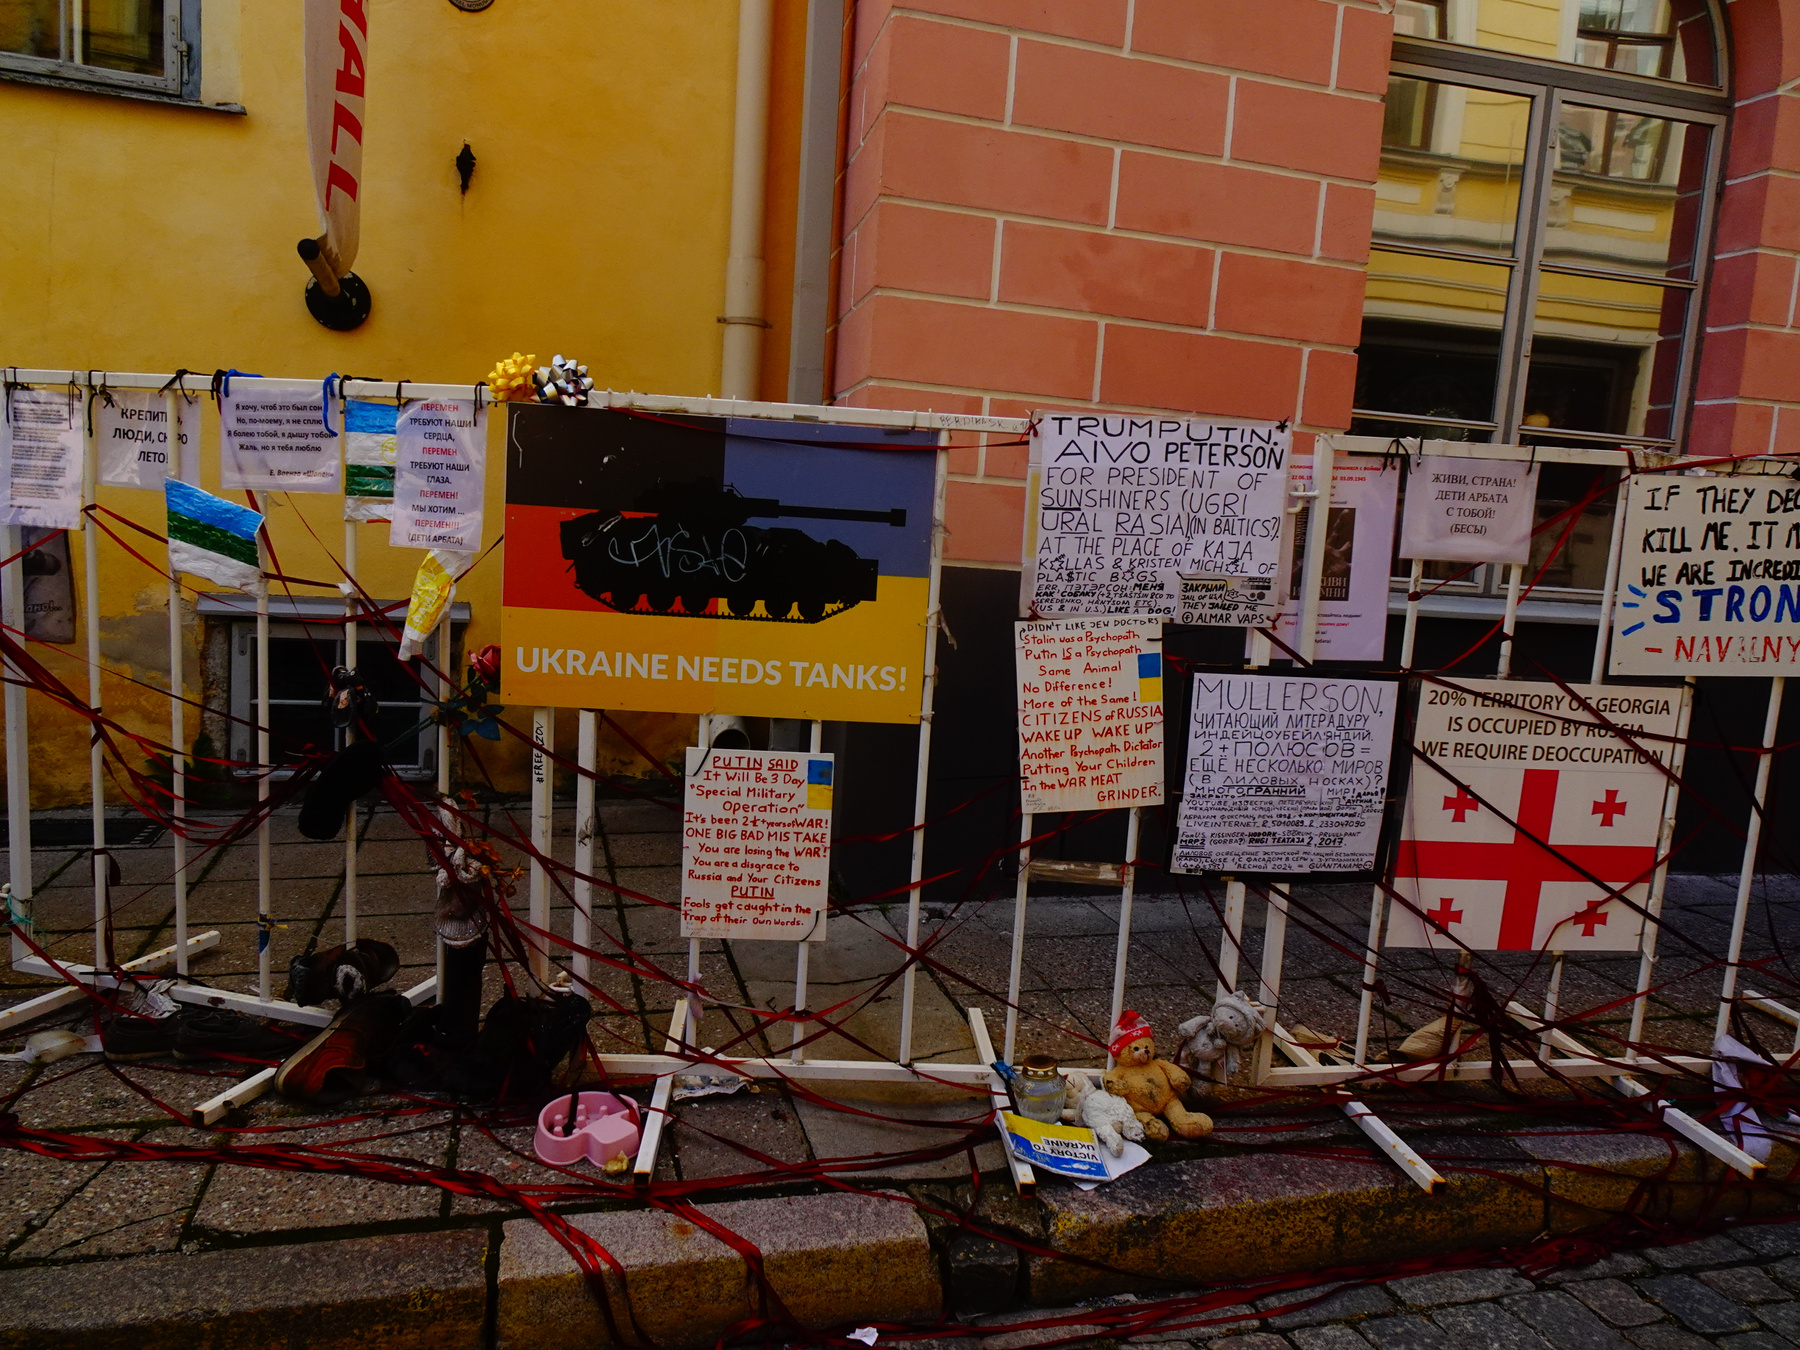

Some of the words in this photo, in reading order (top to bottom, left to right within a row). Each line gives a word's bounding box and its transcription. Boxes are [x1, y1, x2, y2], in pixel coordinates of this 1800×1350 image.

[241, 404, 259, 412] хочу,
[420, 403, 459, 412] ПЕРЕМЕН
[410, 418, 443, 426] ТРЕБУЮТ
[445, 419, 472, 428] НАШИ
[113, 428, 155, 443] ЛЮДИ,
[257, 430, 280, 438] тобой,
[424, 432, 455, 442] СЕРДЦА,
[1052, 416, 1279, 446] TRUMPUTIN.
[295, 444, 321, 452] люблю
[422, 447, 457, 456] ПЕРЕМЕН
[1054, 440, 1151, 464] AIVO
[1164, 440, 1284, 470] PETERSON
[410, 461, 444, 470] ТРЕБУЮТ
[446, 463, 470, 472] НАШИ
[427, 476, 452, 484] ГЛАЗА.
[1047, 466, 1095, 487] FOR
[1108, 466, 1220, 490] PRESIDENT
[1237, 472, 1268, 491] OF
[1432, 473, 1468, 485] ЖИВИ,
[1472, 476, 1517, 488] СТРАНА!
[420, 490, 458, 499] ПЕРЕМЕН!
[1435, 490, 1465, 501] ДЕТИ
[1468, 493, 1508, 503] АРБАТА
[1644, 485, 1680, 511] IF
[1696, 485, 1755, 514] THEY
[412, 504, 426, 512] МЫ
[428, 506, 456, 514] ХОТИМ
[1040, 488, 1170, 511] SUNSHINERS
[1181, 489, 1247, 517] (UGRI
[1446, 507, 1454, 516] С
[1457, 507, 1495, 519] ТОБОЙ!
[415, 519, 459, 529] ПЕРЕМЕН!!!
[1041, 512, 1103, 534] URAL
[1450, 524, 1487, 535] (БЕСЫ)
[408, 533, 430, 542] (ДЕТИ
[432, 536, 463, 546] АРБАТА)
[1642, 527, 1692, 554] KILL
[1700, 521, 1738, 553] ME.
[1746, 521, 1778, 550] IT
[1039, 537, 1063, 555] AT
[1074, 537, 1102, 554] THE
[1112, 538, 1160, 557] PLACE
[1171, 540, 1194, 558] OF
[1203, 540, 1253, 561] KAJA
[1642, 565, 1667, 587] WE
[1675, 560, 1716, 585] ARE
[1182, 602, 1207, 611] THEY
[1209, 602, 1239, 611] JAILED
[1244, 604, 1258, 612] ME
[1027, 623, 1062, 632] DIDN'T
[1065, 621, 1086, 630] LIKE
[1090, 621, 1110, 629] JEW
[1114, 618, 1159, 627] DOCTORS
[1195, 613, 1232, 624] ALMAR
[1237, 613, 1264, 624] VAPS
[1023, 634, 1055, 645] Stalin
[1085, 629, 1140, 643] Psychopath
[1026, 649, 1057, 660] Putin
[1062, 648, 1072, 660] IS
[1086, 645, 1142, 658] Psychopath
[516, 646, 669, 680] UKRAINE
[676, 655, 783, 685] NEEDS
[789, 661, 907, 692] TANKS!
[1039, 665, 1071, 676] Same
[1083, 661, 1122, 673] Animal
[1023, 682, 1040, 693] No
[1197, 678, 1384, 717] MULLERSON,
[1428, 689, 1467, 707] 20%
[1473, 691, 1565, 711] TERRITORY
[1568, 696, 1592, 712] OF
[1596, 697, 1671, 715] GEORGIA
[1022, 709, 1102, 726] CITIZENS
[1117, 705, 1163, 719] RUSSIA
[1194, 712, 1278, 730] ЧИТАЮЩИЙ
[1021, 728, 1063, 743] WAKE
[1064, 728, 1082, 740] UP
[1092, 724, 1130, 738] WAKE
[1135, 722, 1154, 734] UP
[1448, 716, 1463, 732] IS
[1468, 717, 1557, 737] OCCUPIED
[1562, 723, 1584, 737] BY
[1199, 740, 1213, 757] 2
[1234, 741, 1355, 758] ПОЛЮСОВ
[1421, 740, 1450, 757] WE
[1453, 742, 1528, 761] REQUIRE
[1533, 747, 1664, 765] DEOCCUPATION
[534, 752, 544, 783] #FREE
[713, 756, 762, 769] PUTIN
[768, 759, 798, 770] SAID
[1023, 764, 1069, 776] Putting
[1075, 761, 1102, 772] Your
[1106, 758, 1156, 769] Children
[1190, 754, 1228, 773] ЕЩЁ
[1235, 758, 1323, 774] НЕСКОЛЬКО
[1332, 760, 1383, 774] МИРОВ
[703, 770, 721, 781] It
[725, 772, 749, 782] Will
[755, 774, 768, 784] Be
[771, 774, 778, 784] 3
[783, 775, 805, 788] Day
[746, 787, 795, 802] Military
[1097, 786, 1161, 802] GRINDER.
[686, 828, 711, 838] ONE
[716, 829, 737, 839] BIG
[741, 830, 764, 840] BAD
[698, 843, 719, 853] You
[723, 847, 740, 855] are
[745, 844, 772, 858] losing
[776, 847, 789, 857] the
[794, 847, 827, 858] WAR!
[688, 870, 722, 881] Russia
[747, 875, 768, 883] Your
[774, 875, 821, 886] Citizens
[731, 886, 775, 898] PUTIN
[1043, 1139, 1095, 1151] UKRAINE
[1051, 1149, 1098, 1161] VICTORY
